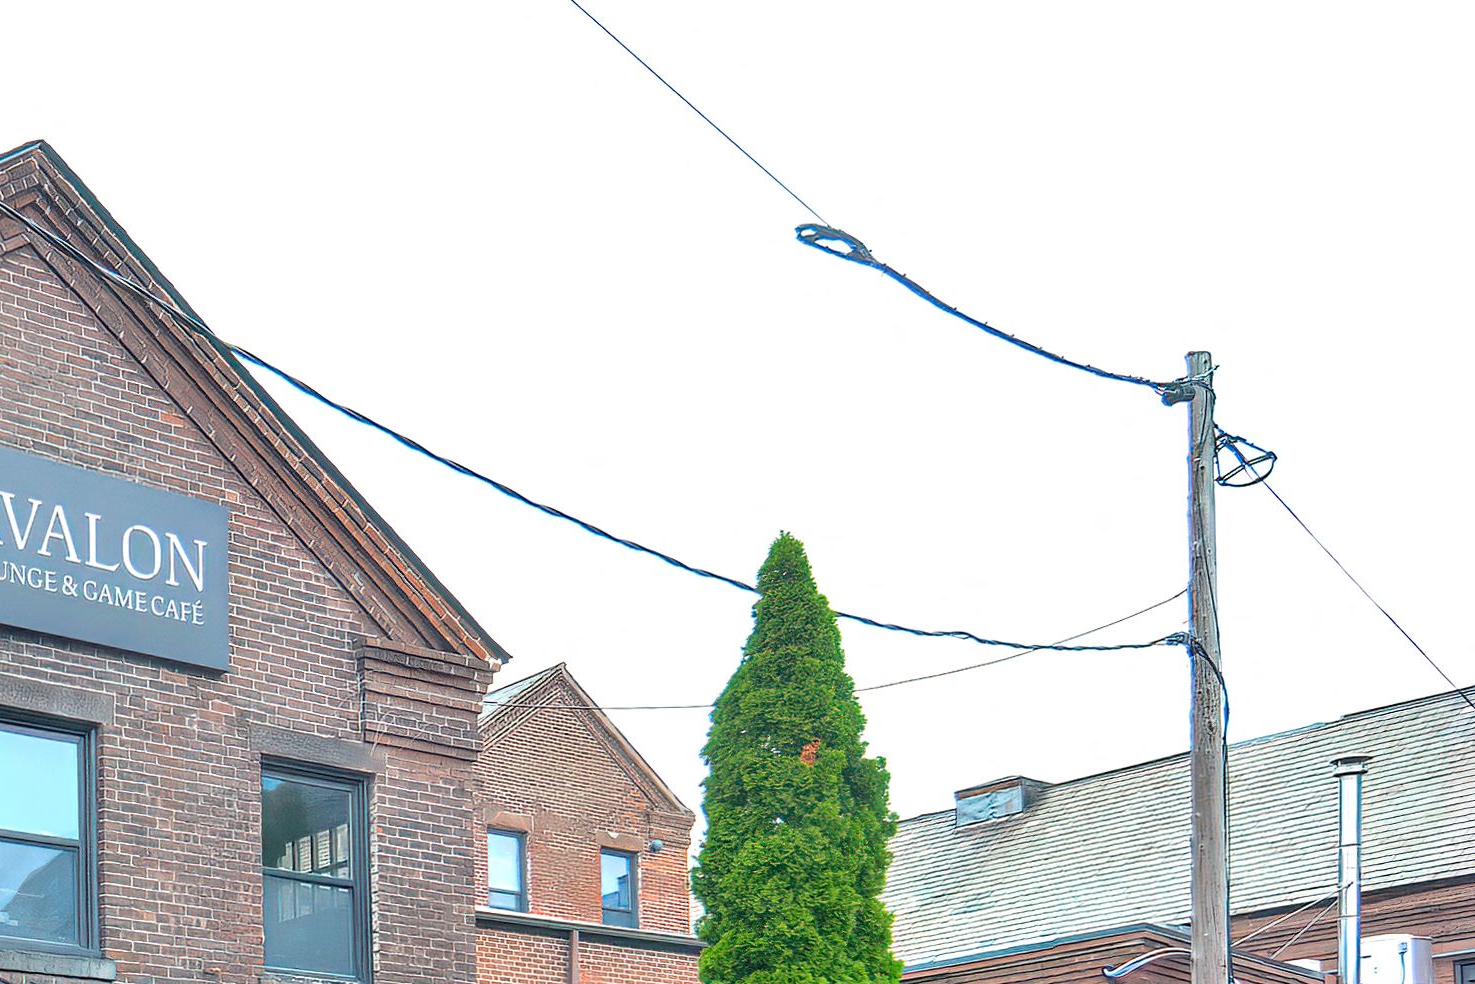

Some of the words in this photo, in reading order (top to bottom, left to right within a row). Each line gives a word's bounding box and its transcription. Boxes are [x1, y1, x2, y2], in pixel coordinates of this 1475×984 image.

[62, 574, 79, 598] &
[83, 579, 148, 614] GAME
[150, 595, 206, 626] CAFÉ
